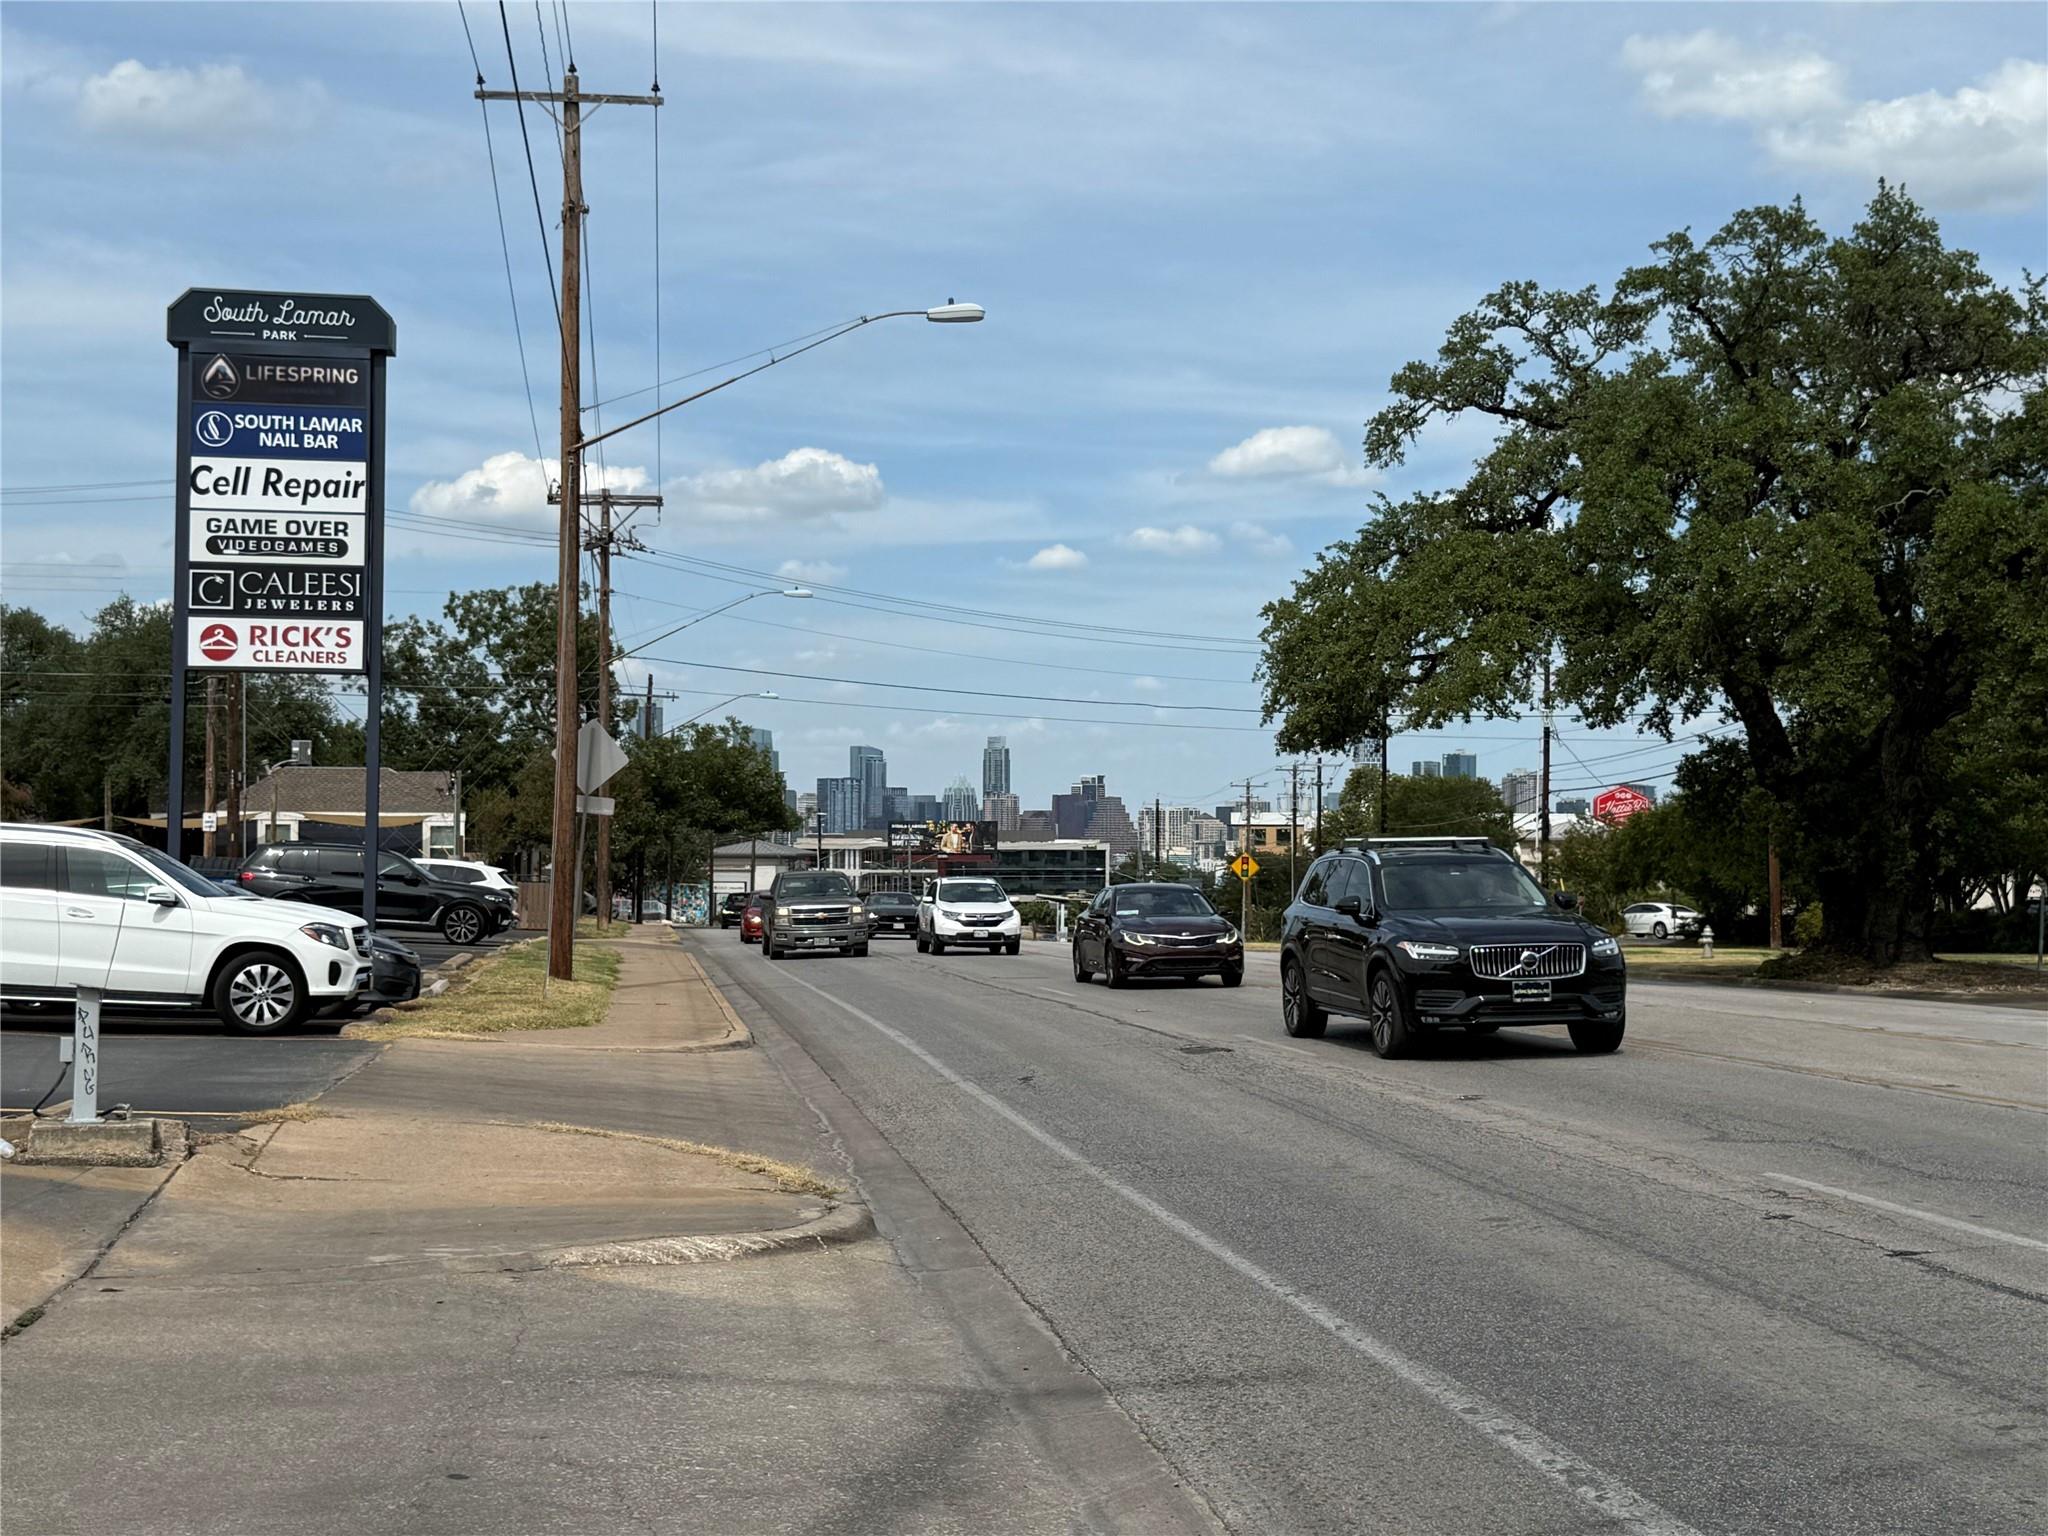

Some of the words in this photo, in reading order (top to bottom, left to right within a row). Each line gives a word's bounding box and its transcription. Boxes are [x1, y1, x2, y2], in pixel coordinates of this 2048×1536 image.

[203, 296, 269, 323] South
[272, 300, 356, 326] Lamar
[263, 330, 297, 341] PARK
[246, 365, 359, 384] LIFESPRING
[234, 414, 294, 430] SOUTH
[300, 417, 363, 433] LAMAR
[259, 432, 299, 448] NAIL
[303, 434, 338, 449] BAR
[190, 464, 252, 496] Cell
[262, 467, 366, 506] Repair
[206, 518, 278, 535] GAME
[285, 520, 349, 537] OVER
[217, 538, 339, 553] VIDEOGAMES
[239, 571, 361, 597] CALEESI
[244, 598, 354, 611] JEWELERS
[249, 625, 351, 648] RICK'S
[252, 650, 348, 664] CLEANERS
